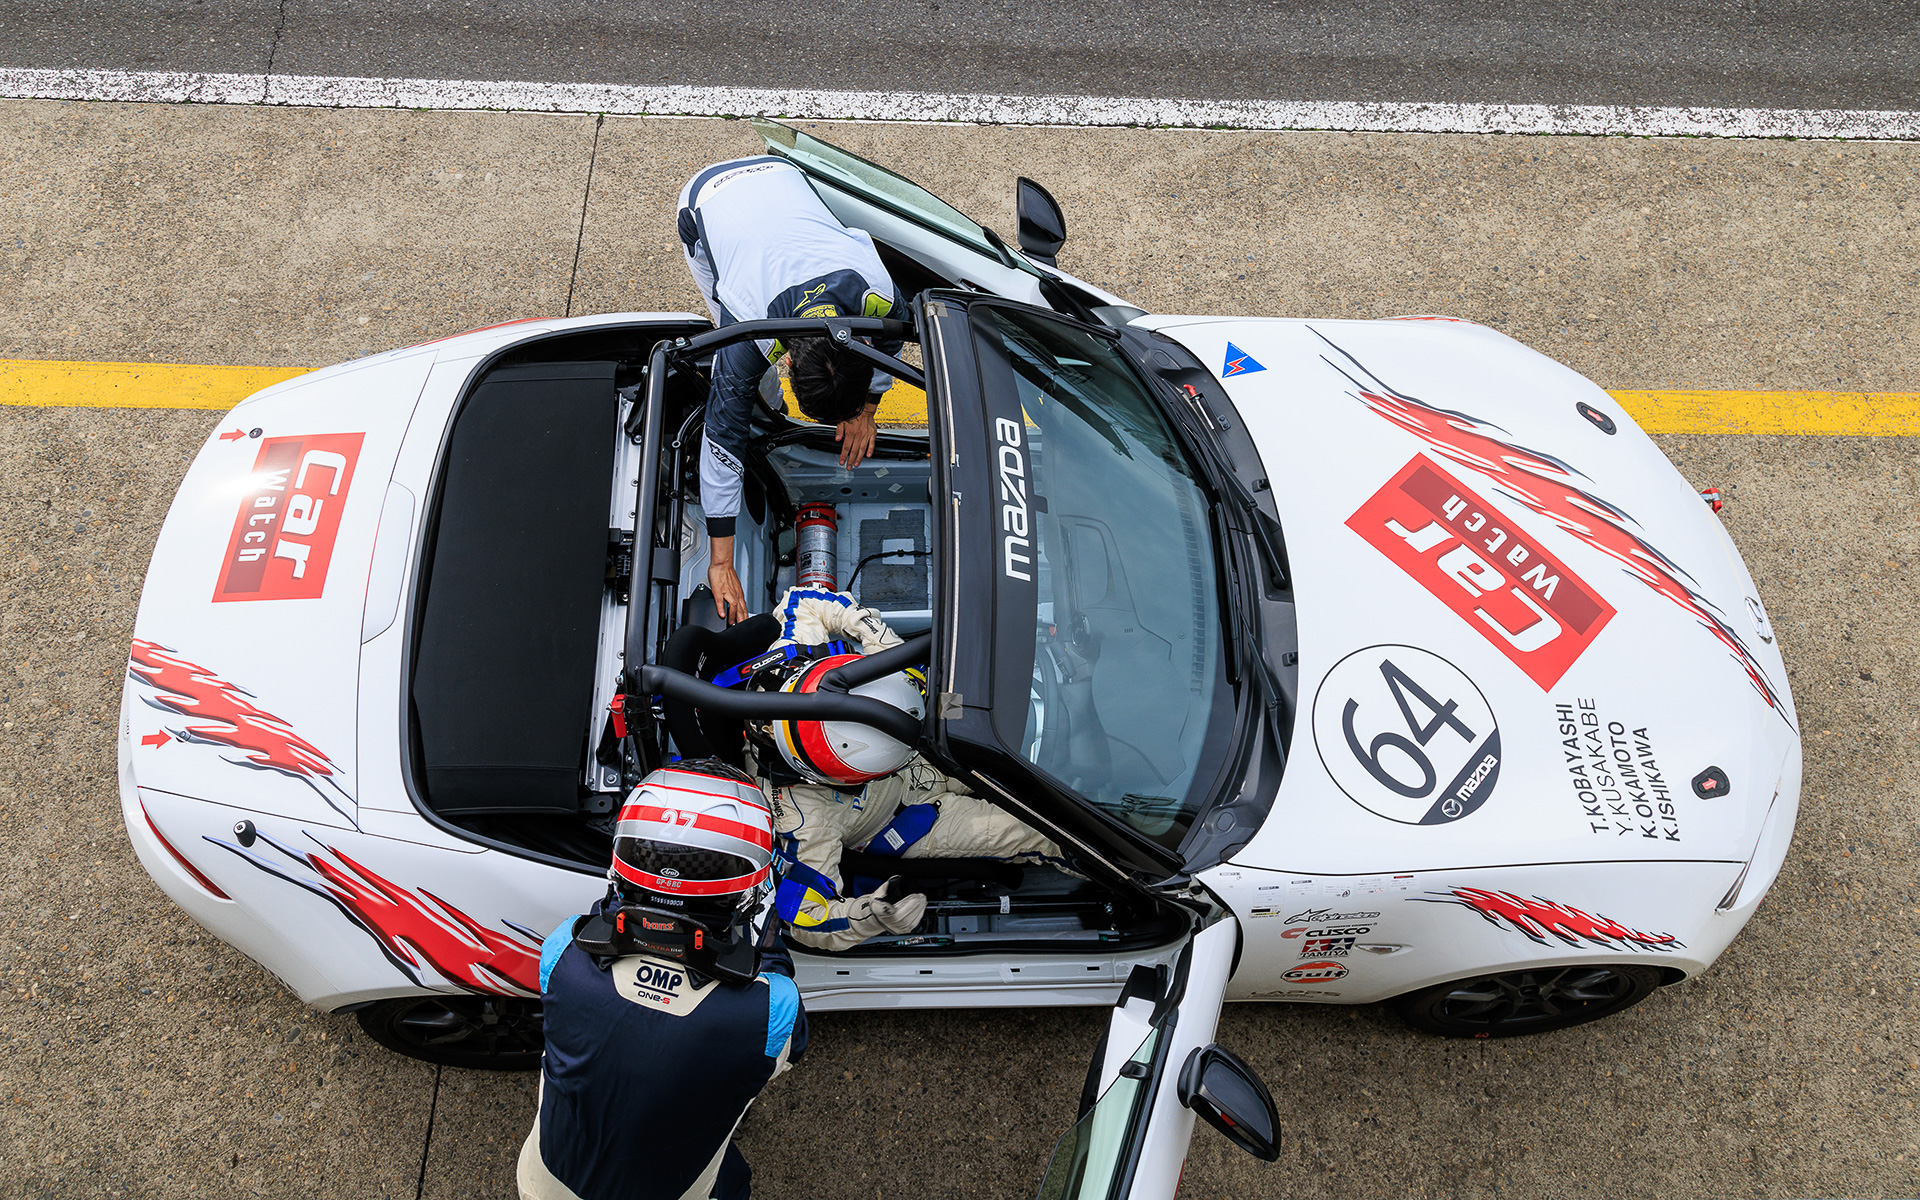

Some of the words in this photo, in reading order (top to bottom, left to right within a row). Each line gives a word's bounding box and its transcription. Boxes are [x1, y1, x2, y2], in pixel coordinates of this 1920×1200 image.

[238, 468, 291, 562] Watch
[274, 450, 347, 578] Car
[995, 417, 1031, 582] mazda
[1441, 494, 1560, 601] Watch
[1383, 517, 1562, 652] Car
[1342, 659, 1477, 798] 64
[1456, 754, 1498, 801] mazda
[1555, 704, 1609, 833] T.KOBAYASHI
[1578, 698, 1633, 836] Y.KUSAKABE
[1608, 721, 1658, 839] K.OKAMOTO
[659, 809, 698, 840] 27
[1633, 727, 1680, 841] K.ISHIKAWA
[643, 917, 674, 930] hans
[1284, 970, 1346, 978] Gulf
[1300, 950, 1349, 958] TAMIYA
[1305, 927, 1370, 937] CUSCO
[636, 965, 683, 991] OMP
